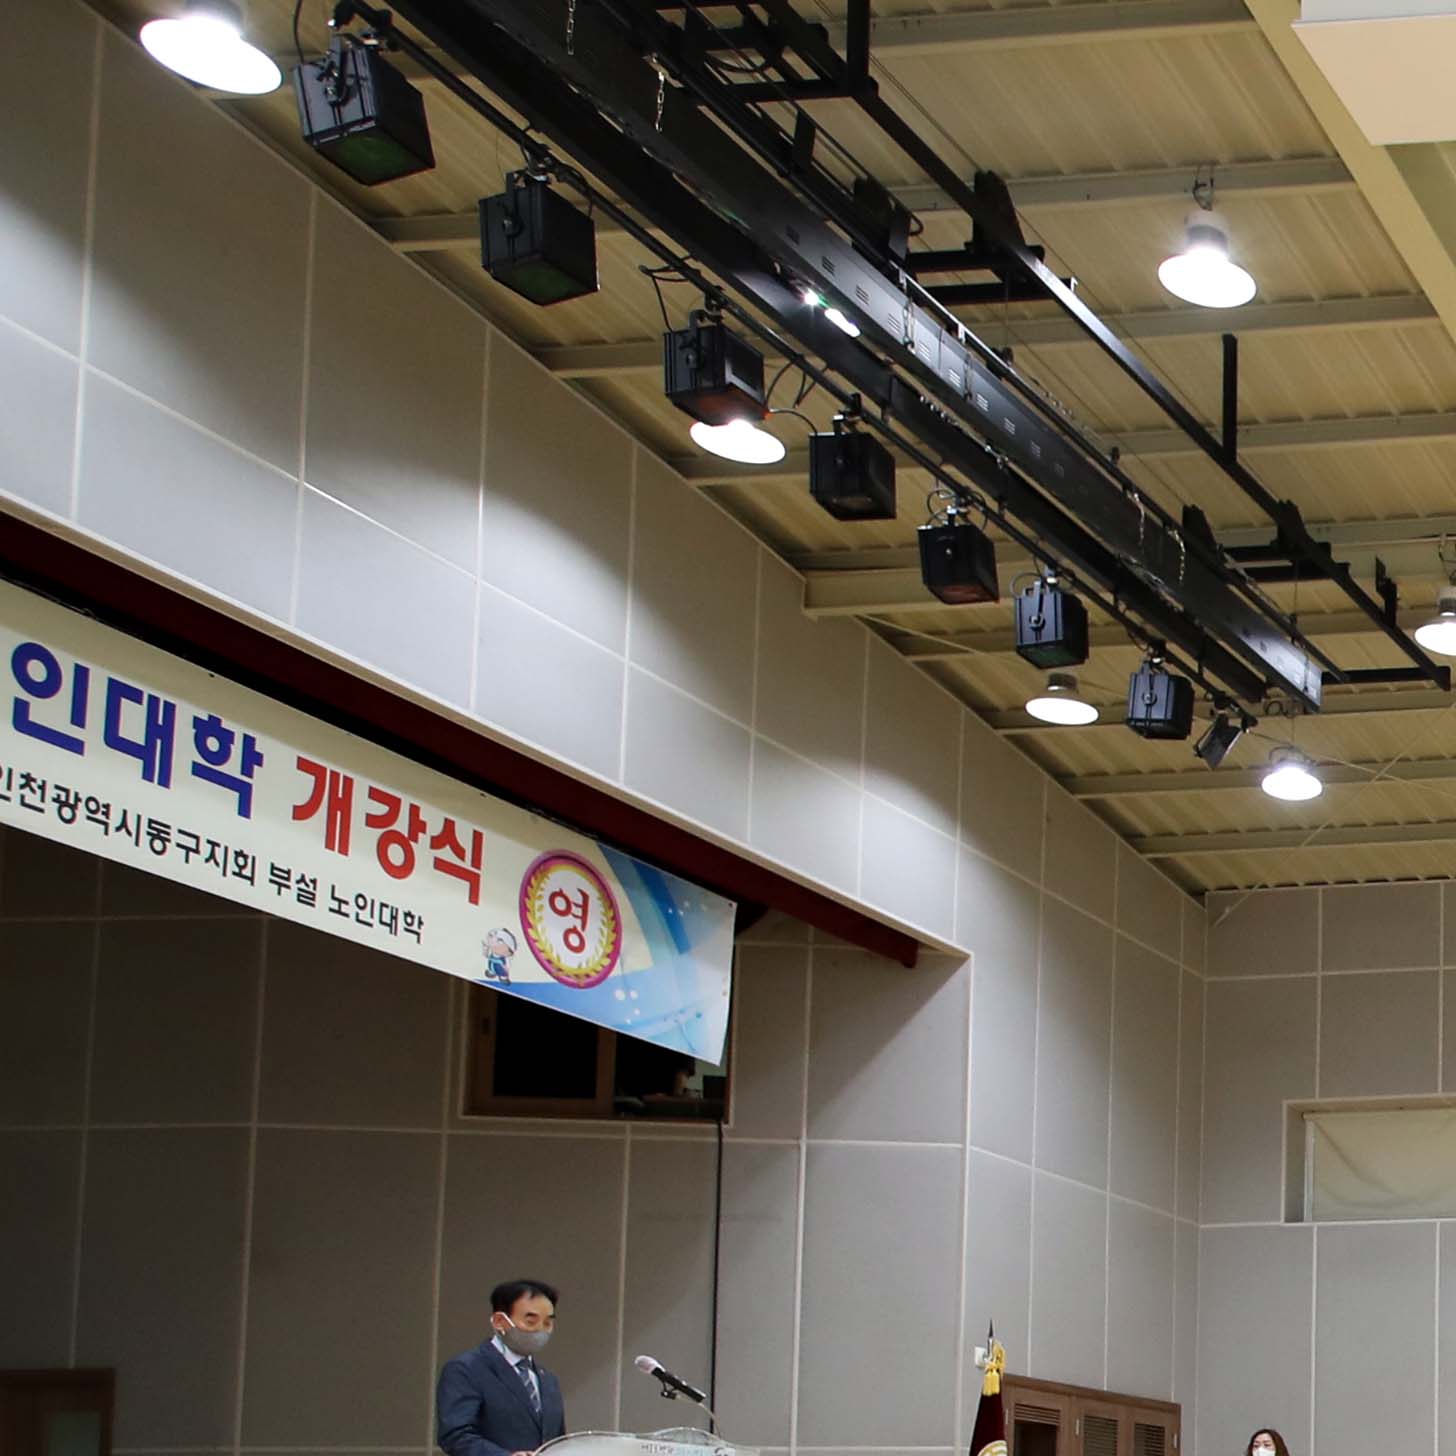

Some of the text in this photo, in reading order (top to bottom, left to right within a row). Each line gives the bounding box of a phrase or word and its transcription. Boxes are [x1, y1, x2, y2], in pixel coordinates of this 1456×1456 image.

[11, 642, 485, 906] 인대학 개강식
[268, 862, 318, 908] 부설
[328, 884, 425, 945] 노인대학
[548, 887, 590, 955] 영
